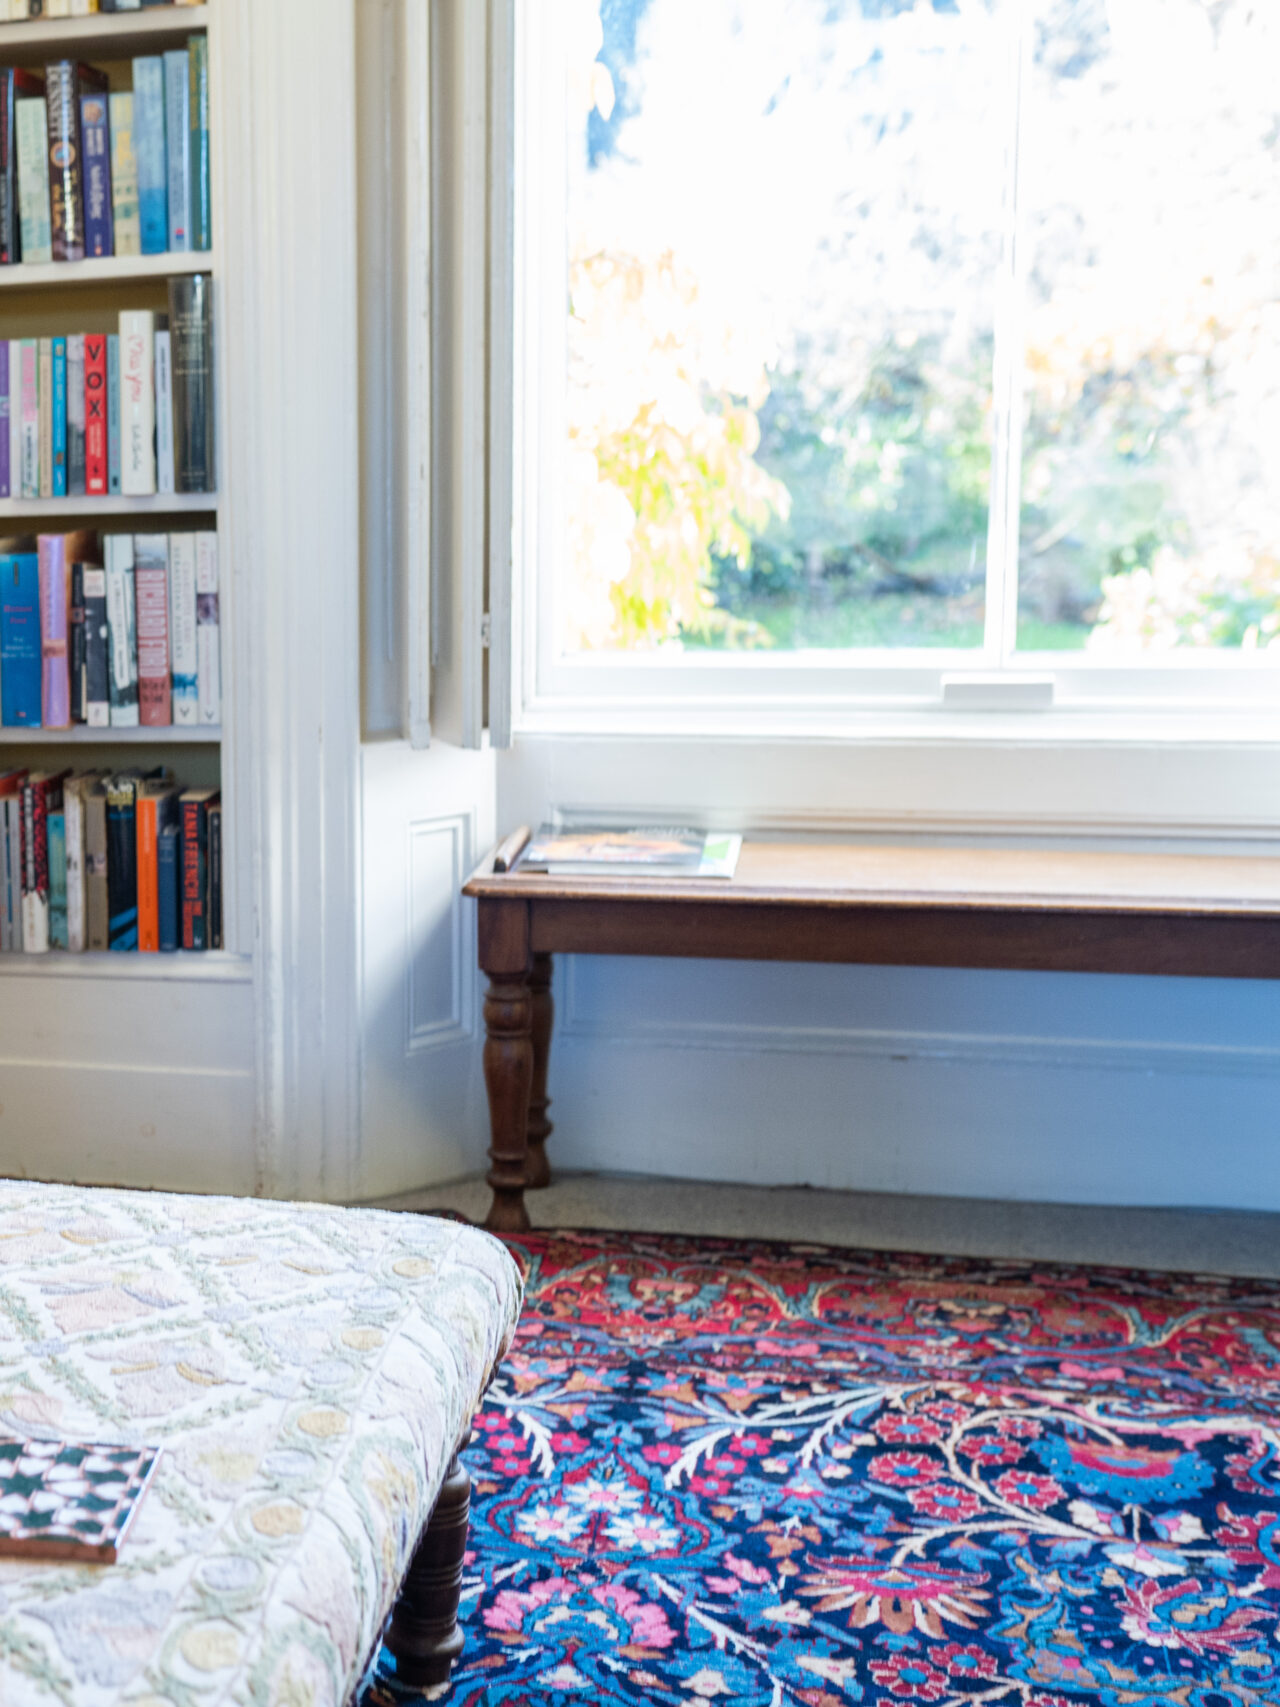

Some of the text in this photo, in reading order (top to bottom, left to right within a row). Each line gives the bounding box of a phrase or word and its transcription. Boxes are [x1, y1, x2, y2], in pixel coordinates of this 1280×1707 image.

[86, 344, 103, 417] VOX
[174, 547, 182, 610] SEBASTIAN
[137, 570, 167, 678] RICHARD FORD
[184, 803, 199, 899] TANA FRENCH
